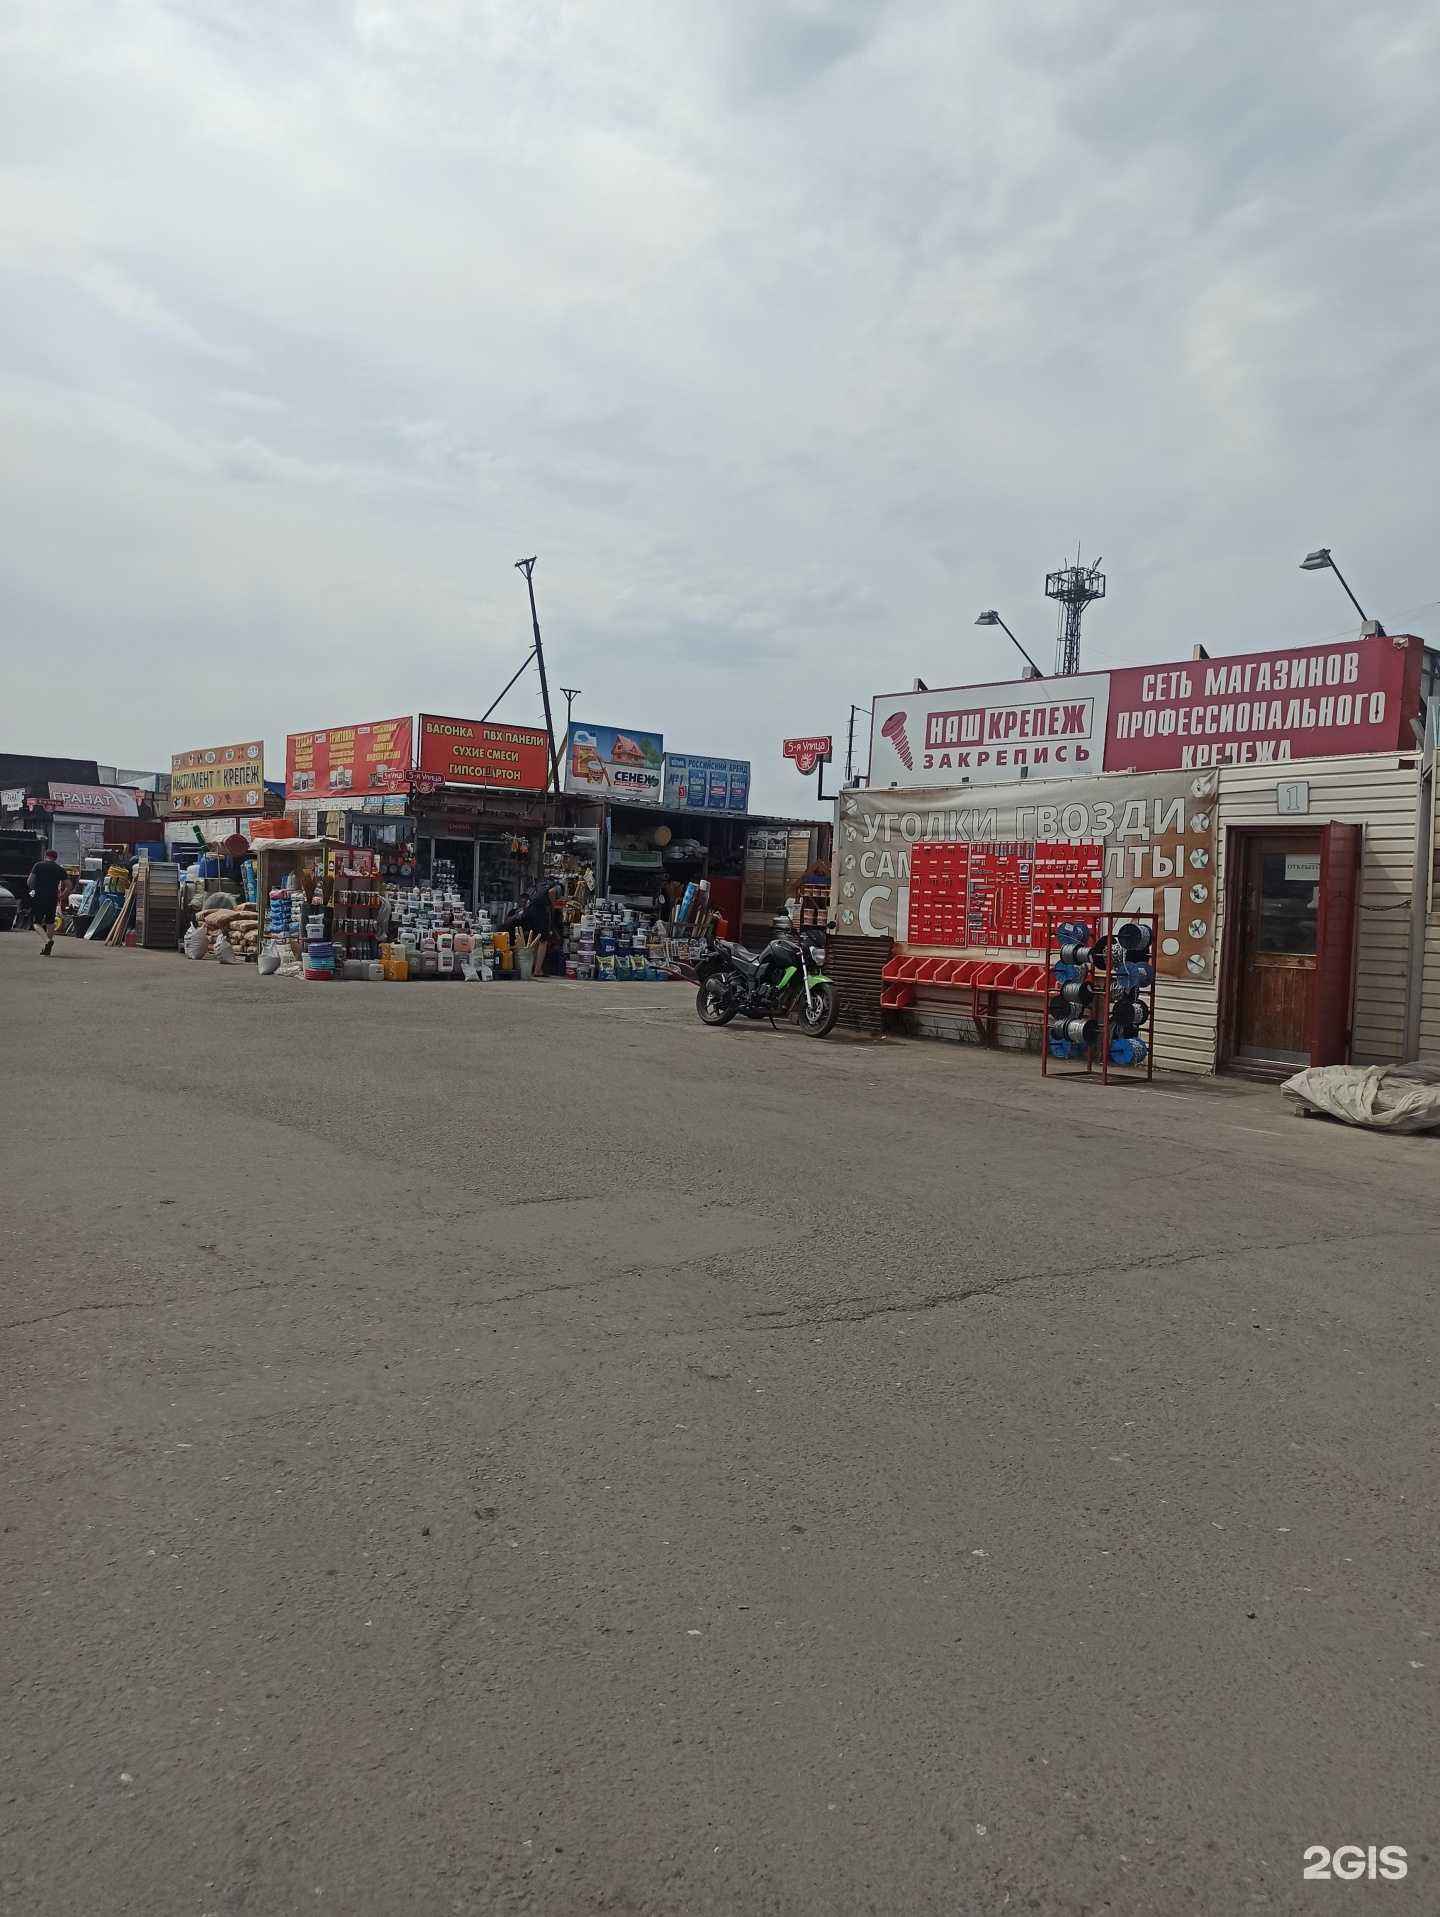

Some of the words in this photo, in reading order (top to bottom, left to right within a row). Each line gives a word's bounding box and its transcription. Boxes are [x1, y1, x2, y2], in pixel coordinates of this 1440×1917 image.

[1142, 671, 1192, 702] СЕТЬ
[1205, 652, 1360, 697] МАГАЗИНОВ
[930, 714, 980, 744] НАШ
[988, 704, 1086, 740] КРЕПЕЖ
[1116, 691, 1386, 739] ПРОФЕССИОНАЛЬНОГО
[426, 723, 473, 738] ВАГОНКА
[483, 730, 502, 742] ПВХ
[505, 734, 544, 746] ПАНЕЛИ
[452, 746, 485, 759] СУХИЕ
[486, 749, 519, 763] СМЕСИ
[923, 745, 1090, 769] ЗАКРЕПИСЬ
[53, 791, 113, 806] ГРАНАТ
[1286, 785, 1300, 810] 1
[863, 806, 998, 844] УГОЛКИ
[1015, 798, 1187, 842] ГВОЗДИ
[860, 850, 910, 879] САМ
[1102, 845, 1185, 878] ЛТЫ
